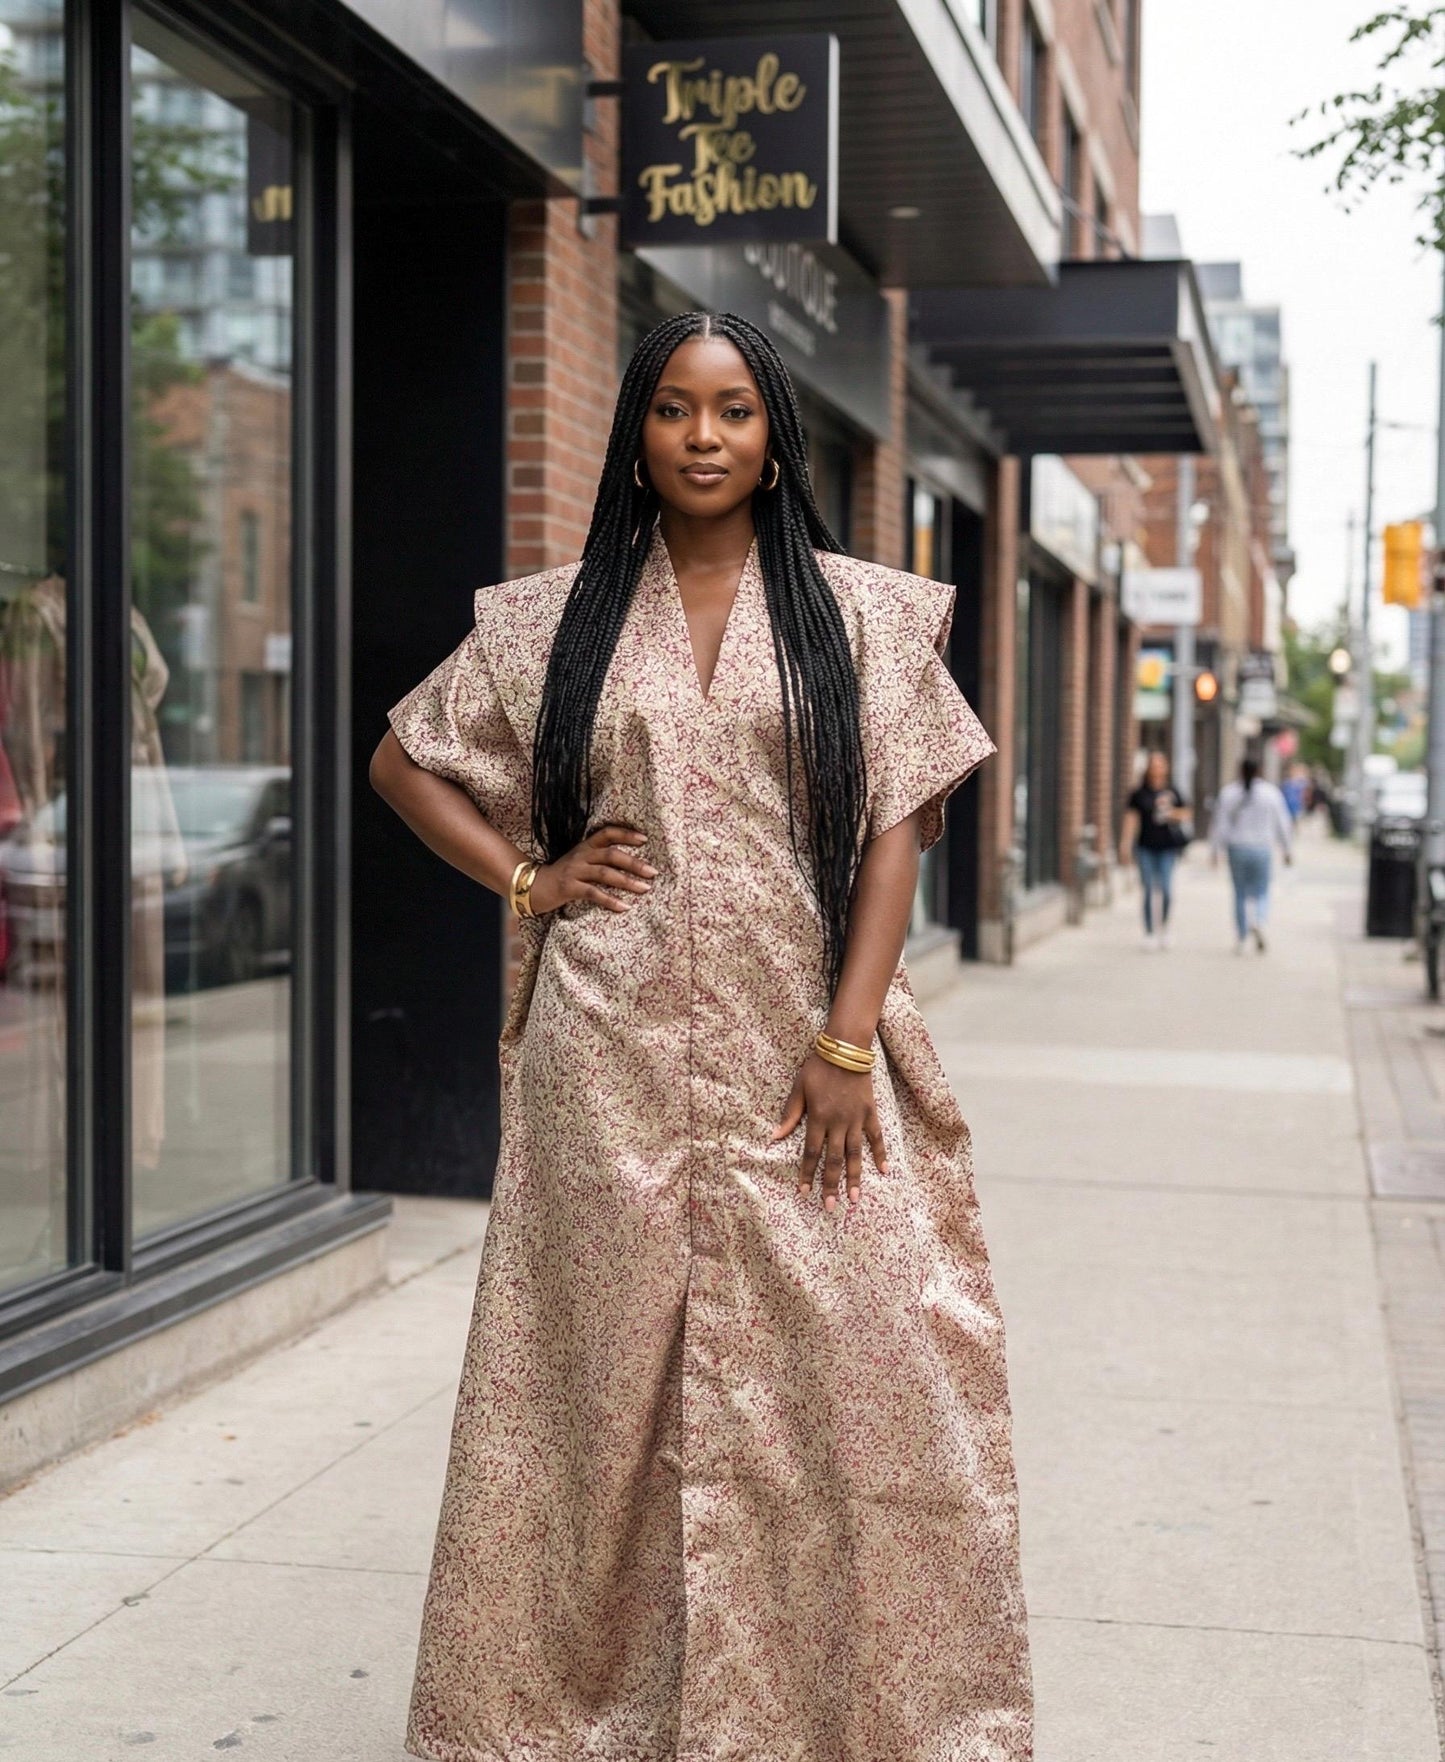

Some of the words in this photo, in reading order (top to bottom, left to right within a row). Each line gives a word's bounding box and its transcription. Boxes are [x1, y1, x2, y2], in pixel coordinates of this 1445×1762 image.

[647, 52, 807, 129] Triple
[677, 122, 757, 177] Tee
[638, 160, 818, 227] Fashion
